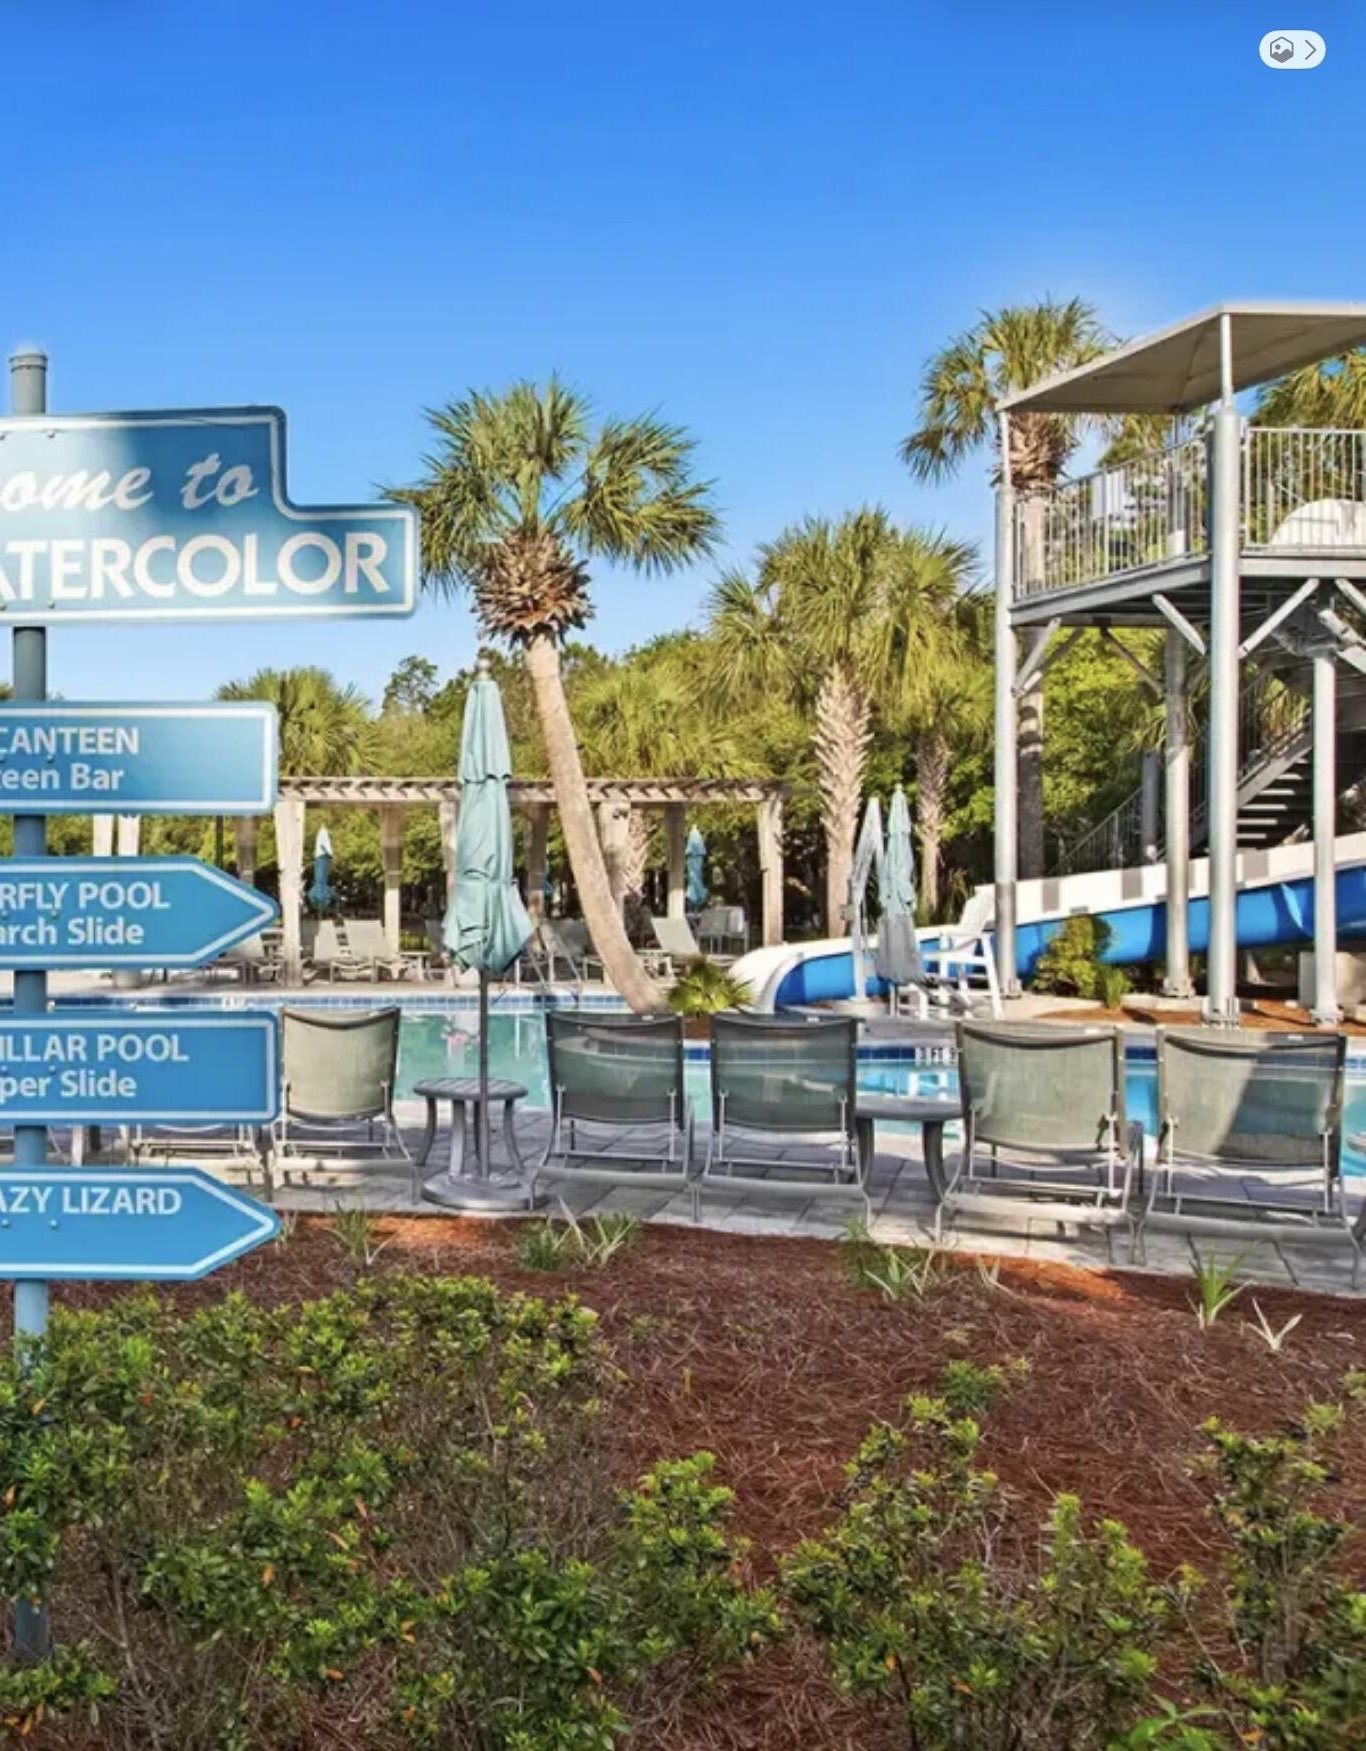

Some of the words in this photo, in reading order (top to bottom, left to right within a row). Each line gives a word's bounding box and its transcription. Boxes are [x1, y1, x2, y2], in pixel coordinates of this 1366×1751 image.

[180, 452, 259, 507] to
[70, 764, 125, 790] Bar
[79, 883, 170, 910] POOL
[67, 918, 144, 945] Slide
[97, 1035, 189, 1062] POOL
[60, 1070, 137, 1098] Slide
[62, 1187, 181, 1216] LIZARD
